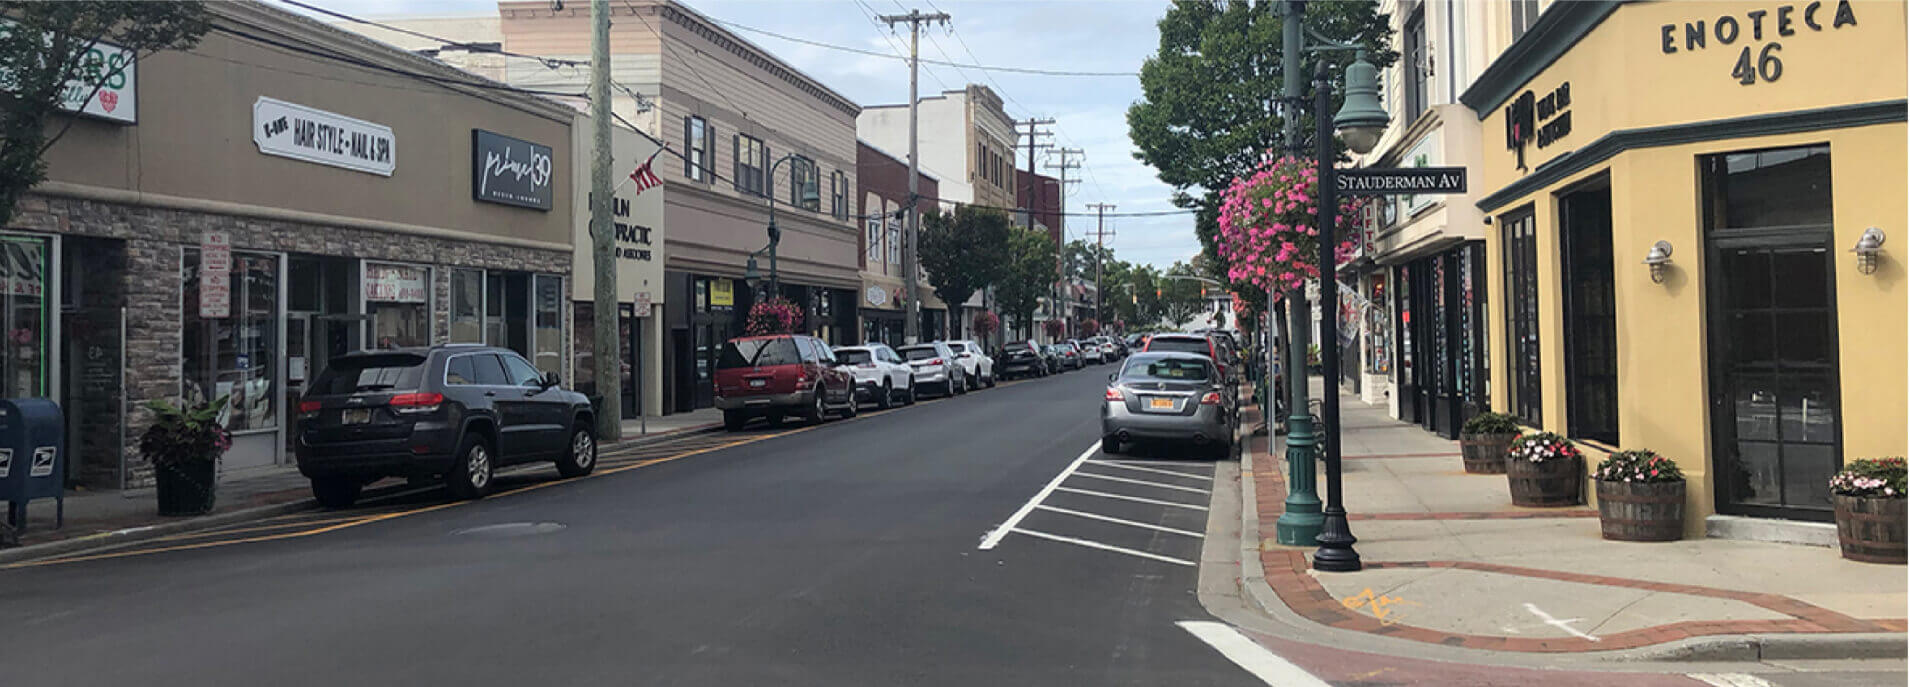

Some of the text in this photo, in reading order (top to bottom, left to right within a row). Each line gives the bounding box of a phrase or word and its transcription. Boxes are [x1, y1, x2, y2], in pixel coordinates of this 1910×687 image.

[1661, 0, 1857, 54] ENOTECA
[1731, 42, 1783, 86] 46
[294, 118, 315, 148] HAIR
[318, 123, 344, 154] STYLE
[350, 132, 368, 159] NAIL
[377, 136, 391, 164] SPA
[1337, 173, 1460, 190] STAUDERMAN AV
[1364, 196, 1374, 252] IFTS
